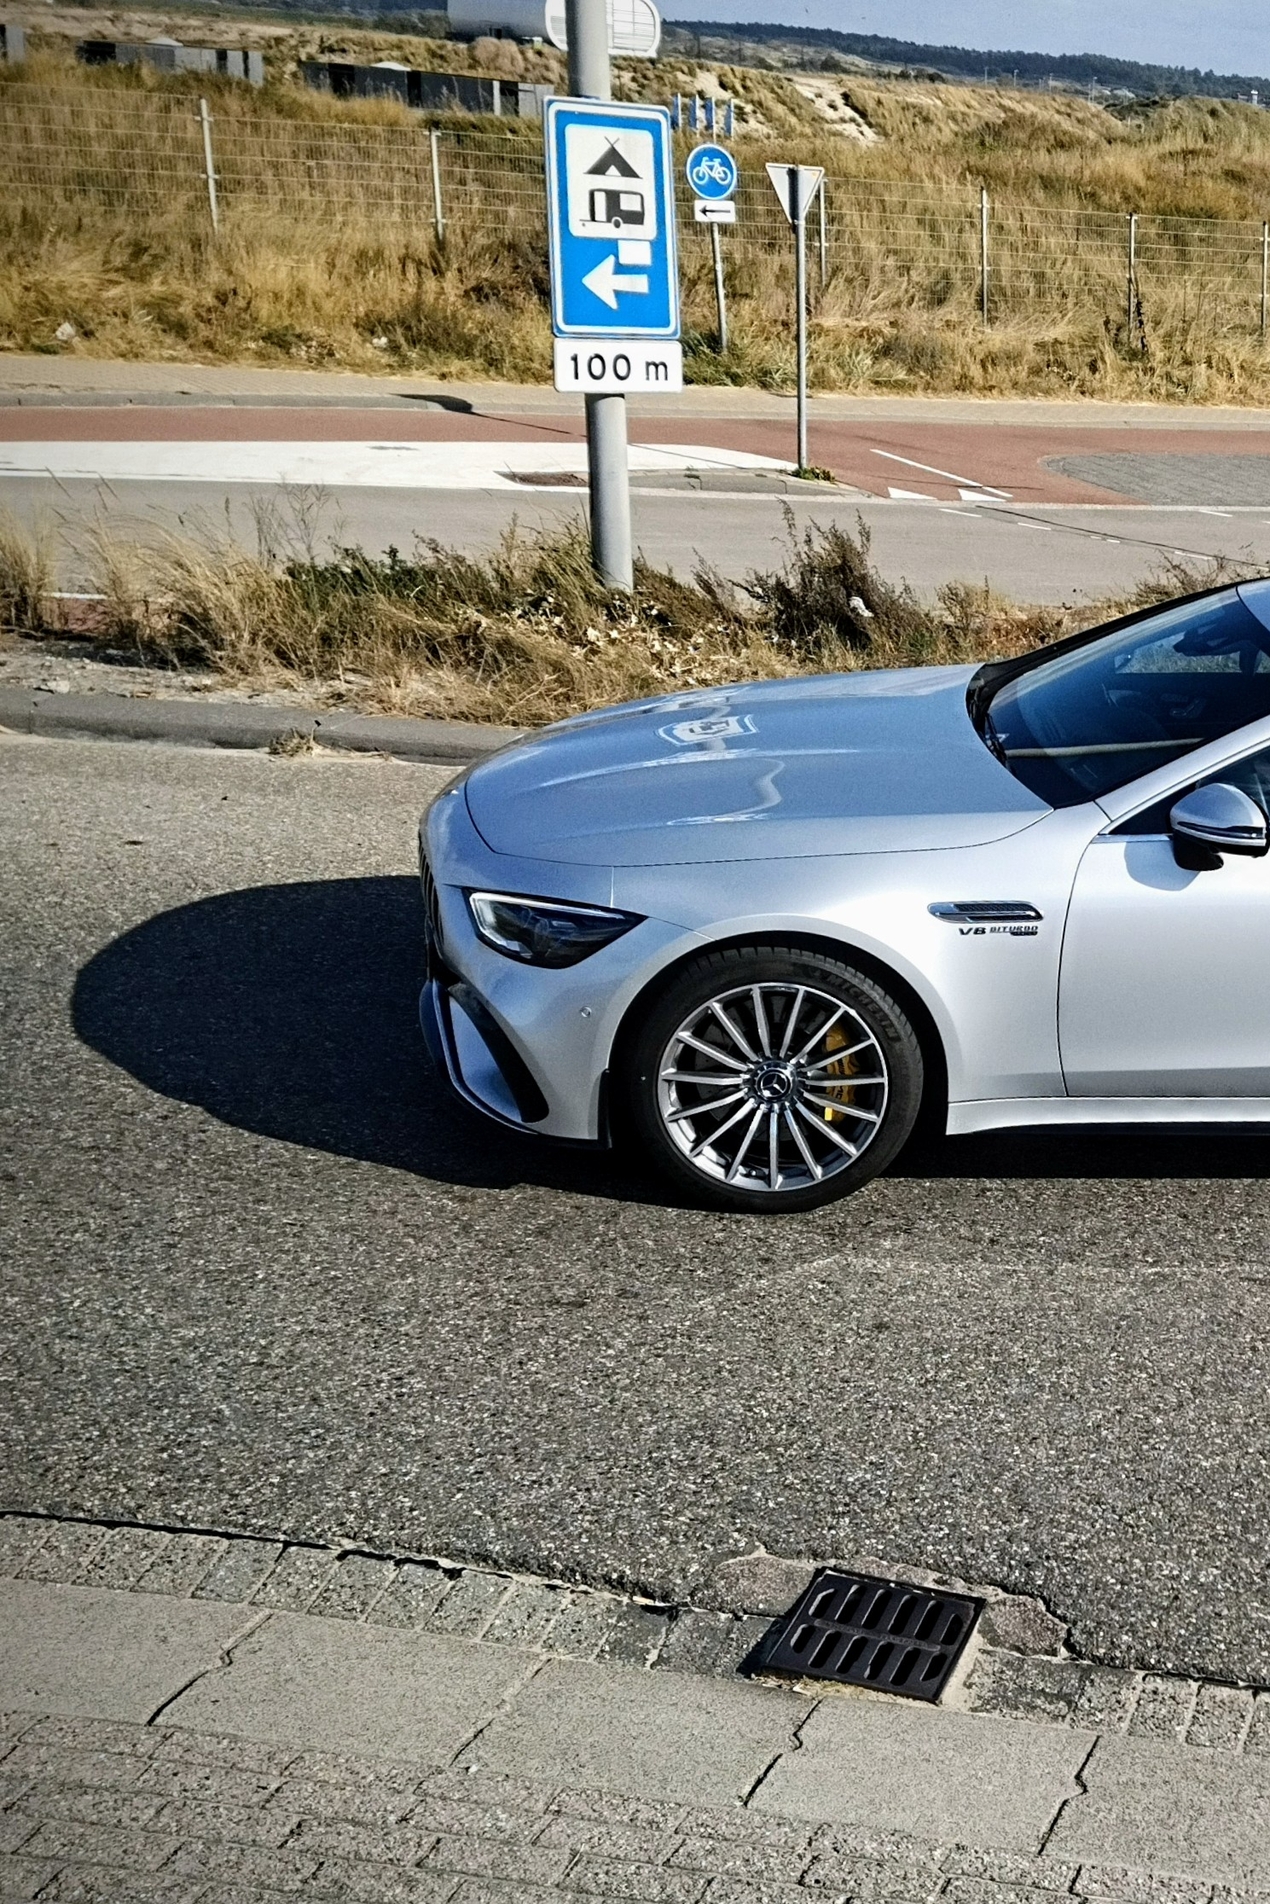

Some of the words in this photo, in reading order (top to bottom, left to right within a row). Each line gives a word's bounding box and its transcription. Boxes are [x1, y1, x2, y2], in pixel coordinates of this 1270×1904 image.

[570, 353, 631, 381] 100
[645, 360, 668, 381] m
[959, 927, 986, 936] V8
